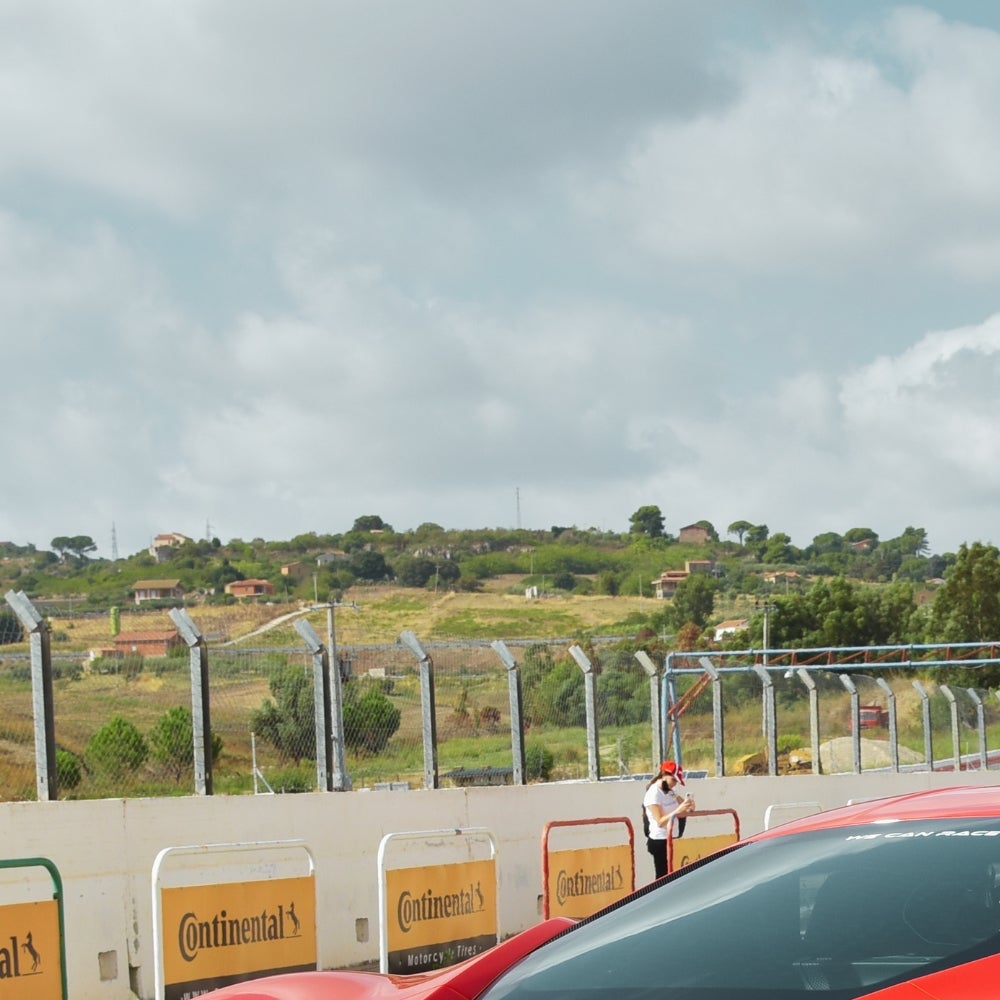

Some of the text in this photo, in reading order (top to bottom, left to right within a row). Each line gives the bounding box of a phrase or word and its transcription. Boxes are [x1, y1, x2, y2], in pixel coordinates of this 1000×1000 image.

[845, 833, 882, 841] WE
[884, 831, 934, 839] CAN
[397, 883, 475, 933] Continental
[556, 868, 615, 907] Continental
[178, 905, 285, 962] Continental
